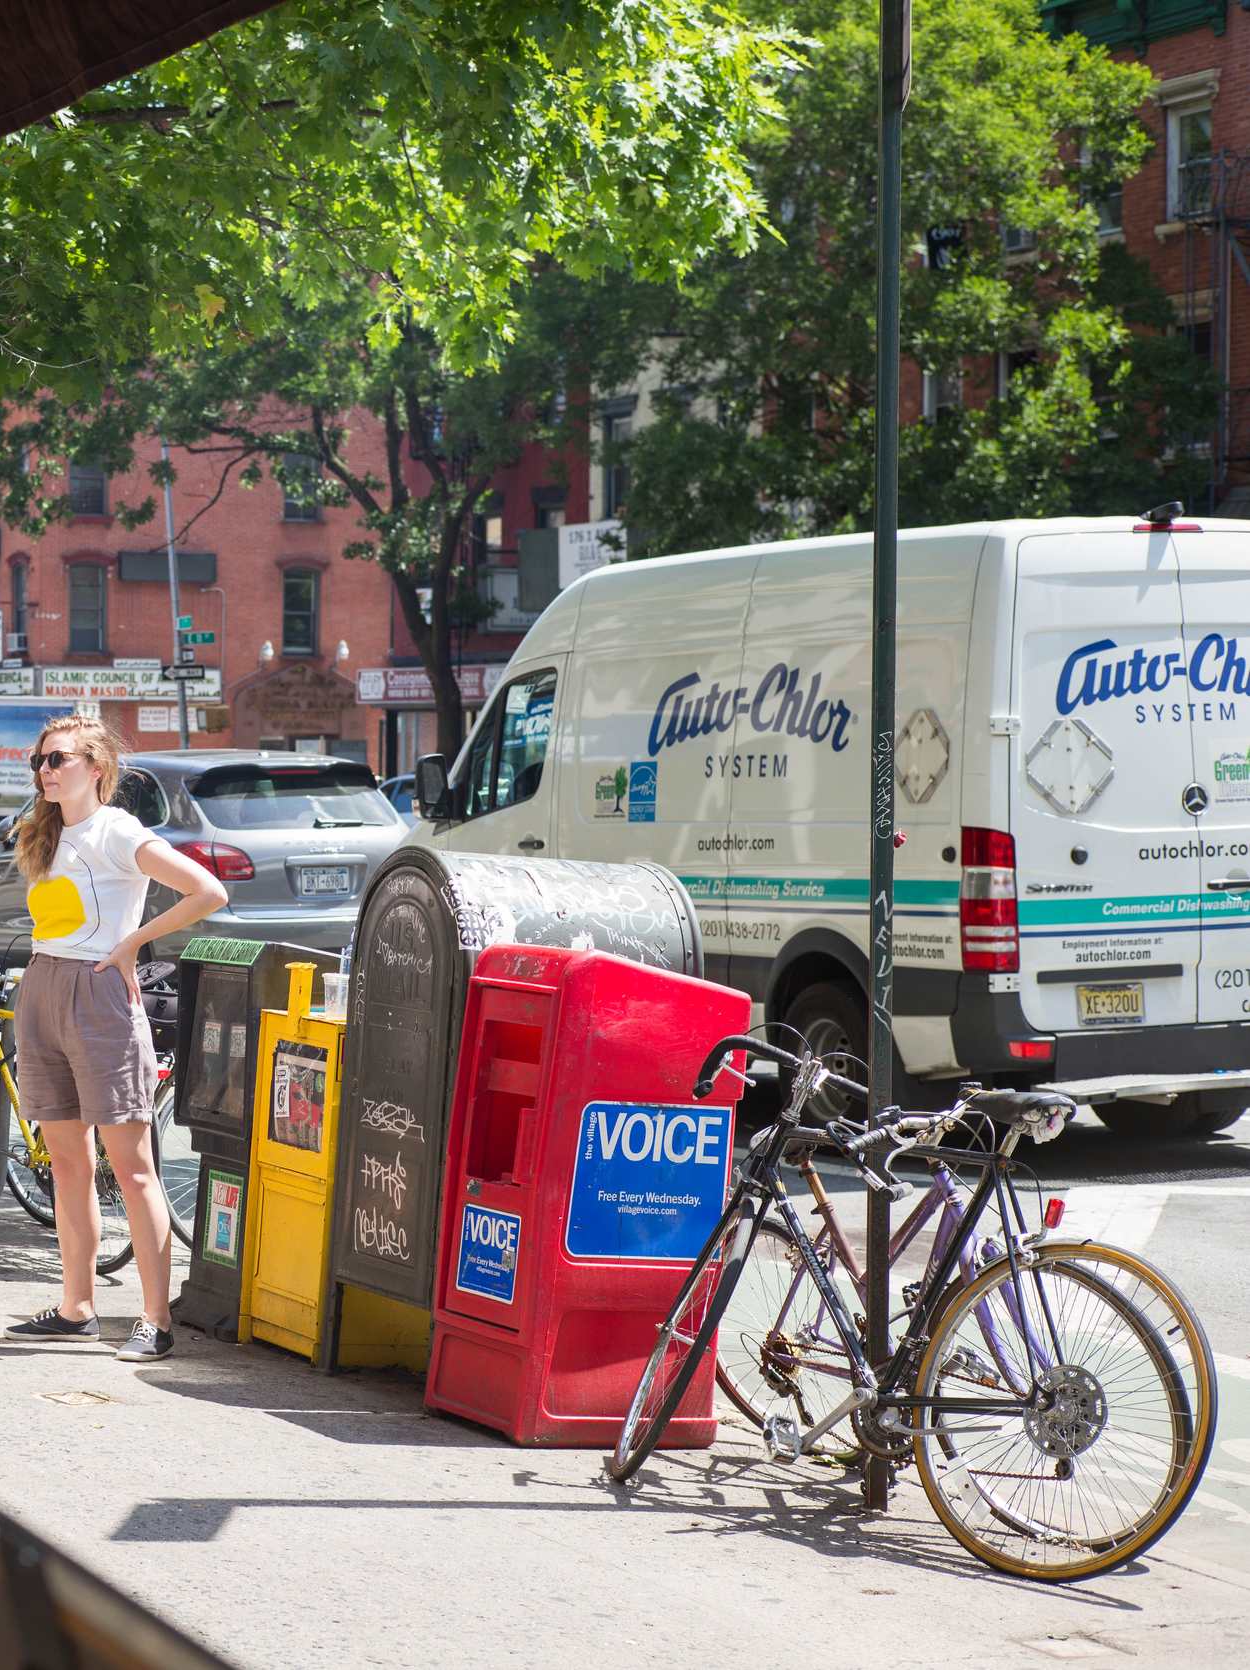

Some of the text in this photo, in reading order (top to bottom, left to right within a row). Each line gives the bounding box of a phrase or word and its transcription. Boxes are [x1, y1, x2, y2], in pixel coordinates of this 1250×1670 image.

[45, 672, 89, 684] ISLAMIC
[93, 673, 138, 685] COUNCIL
[141, 673, 154, 684] OF
[186, 669, 200, 677] WAY
[45, 686, 128, 698] MADINA MASJID
[648, 662, 852, 758] Auto-Chlor
[1136, 702, 1237, 723] SYSTEM
[705, 754, 788, 779] SYSTEM
[1214, 760, 1249, 781] Green
[697, 836, 775, 851] autochlor.com
[1139, 840, 1250, 860] autochlor.co
[712, 880, 780, 899] Dishwashing
[782, 881, 825, 897] Service
[1102, 897, 1250, 916] Commercial Dishwashing
[1062, 941, 1107, 950] Employment
[1110, 937, 1152, 947] Information
[1075, 949, 1152, 963] autochlor.com
[584, 1111, 597, 1160] the village
[598, 1112, 723, 1165] VOICE
[598, 1190, 701, 1206] Free Every Wednesday.
[617, 1205, 677, 1216] villagevoice.com
[470, 1212, 517, 1252] VOICE
[476, 1256, 489, 1267] Every
